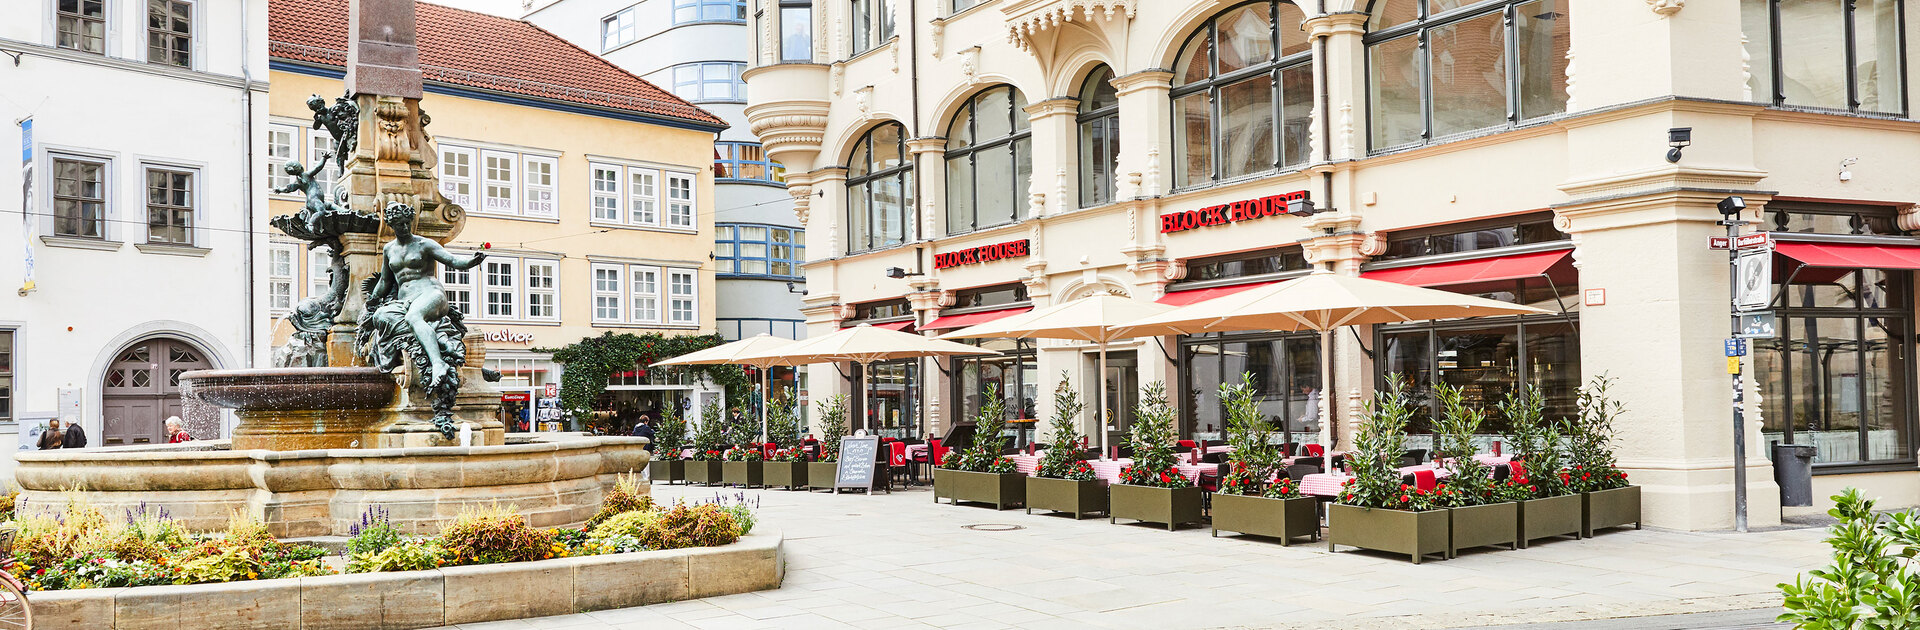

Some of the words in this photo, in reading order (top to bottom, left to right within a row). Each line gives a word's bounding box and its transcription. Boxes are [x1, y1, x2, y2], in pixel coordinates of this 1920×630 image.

[1160, 203, 1228, 234] BLOCK
[934, 247, 978, 270] BLOCK
[978, 239, 1028, 263] HOUSE
[1713, 239, 1728, 248] Anger
